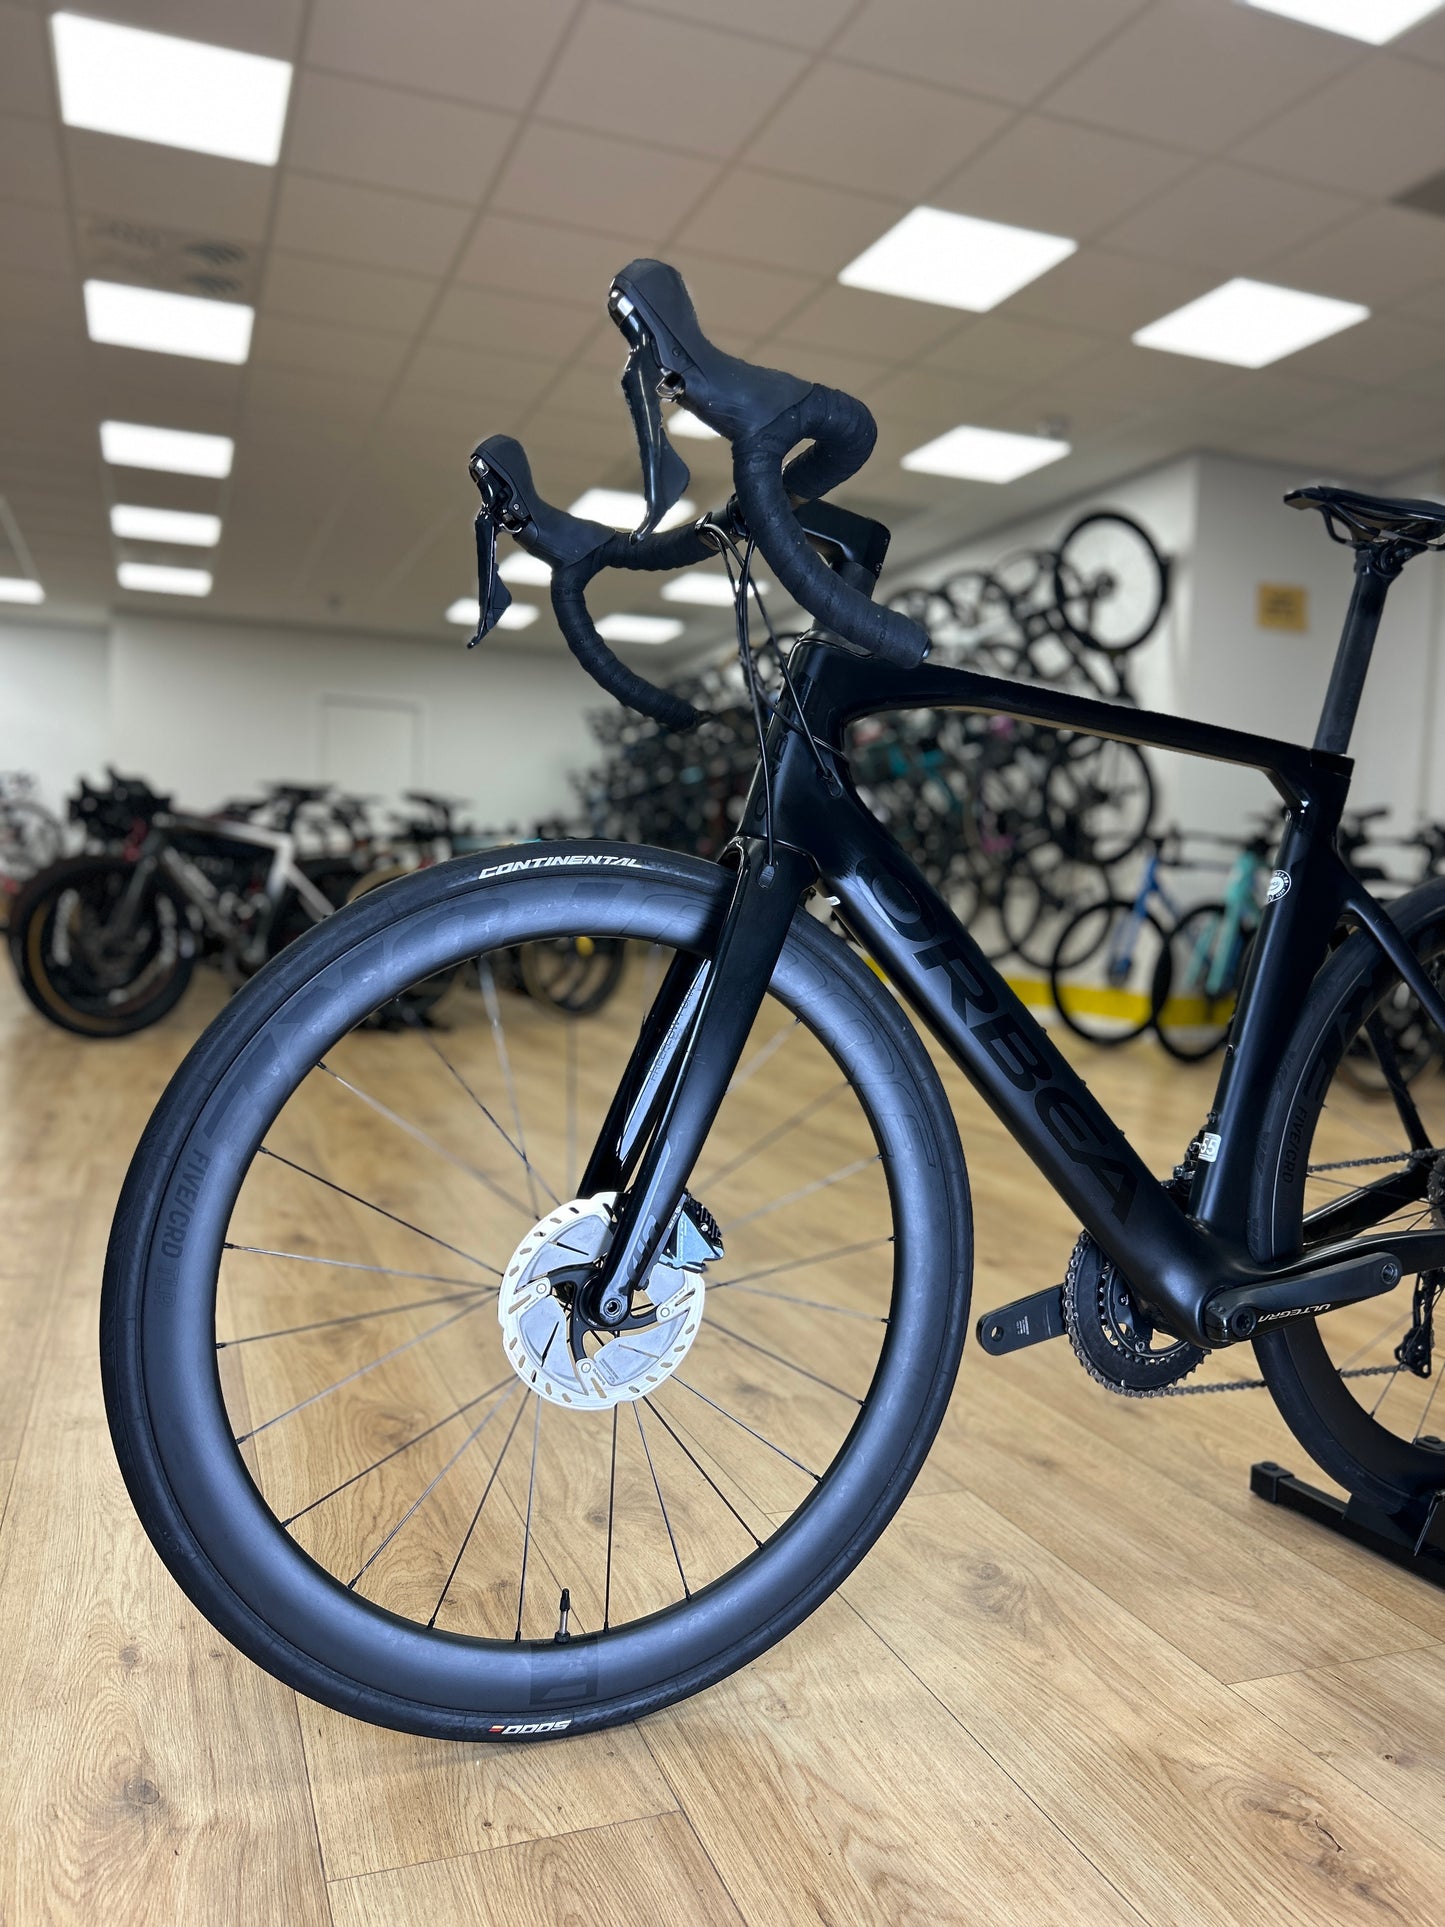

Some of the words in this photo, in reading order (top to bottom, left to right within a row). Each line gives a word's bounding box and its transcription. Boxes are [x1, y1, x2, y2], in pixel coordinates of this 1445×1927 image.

[478, 854, 643, 880] CONTINENTAL
[855, 856, 1140, 1225] ORBEA
[1282, 1105, 1309, 1185] FIVE/CRD
[161, 1149, 212, 1259] FIVE/CRD
[1257, 1302, 1332, 1324] ULTEGRA
[501, 1719, 572, 1735] 5000
